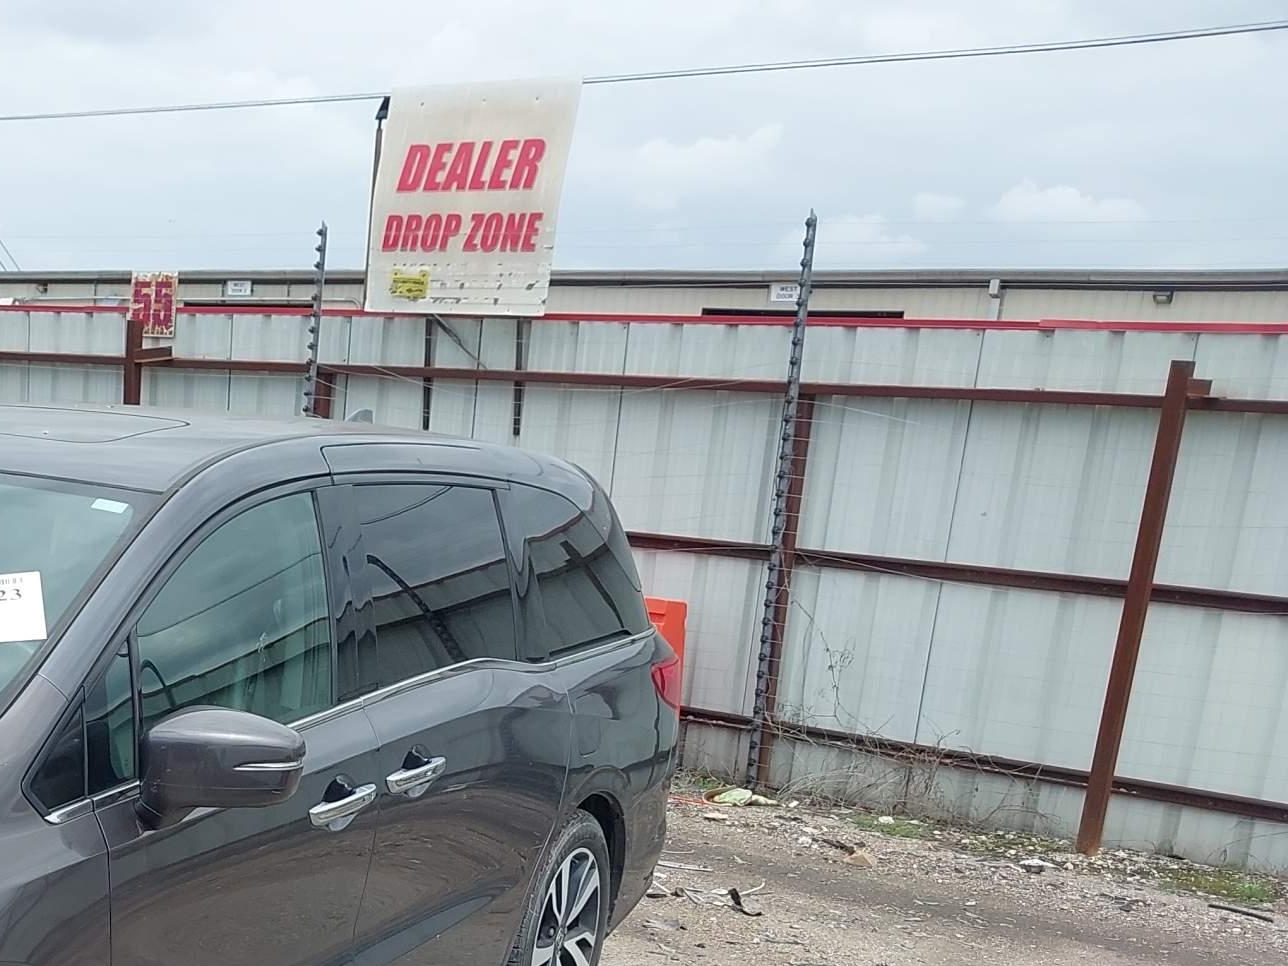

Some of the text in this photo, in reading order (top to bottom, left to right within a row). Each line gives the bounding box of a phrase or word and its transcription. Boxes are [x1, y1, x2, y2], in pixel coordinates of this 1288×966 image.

[397, 138, 547, 193] DEALER
[381, 211, 544, 253] DROP ZONE
